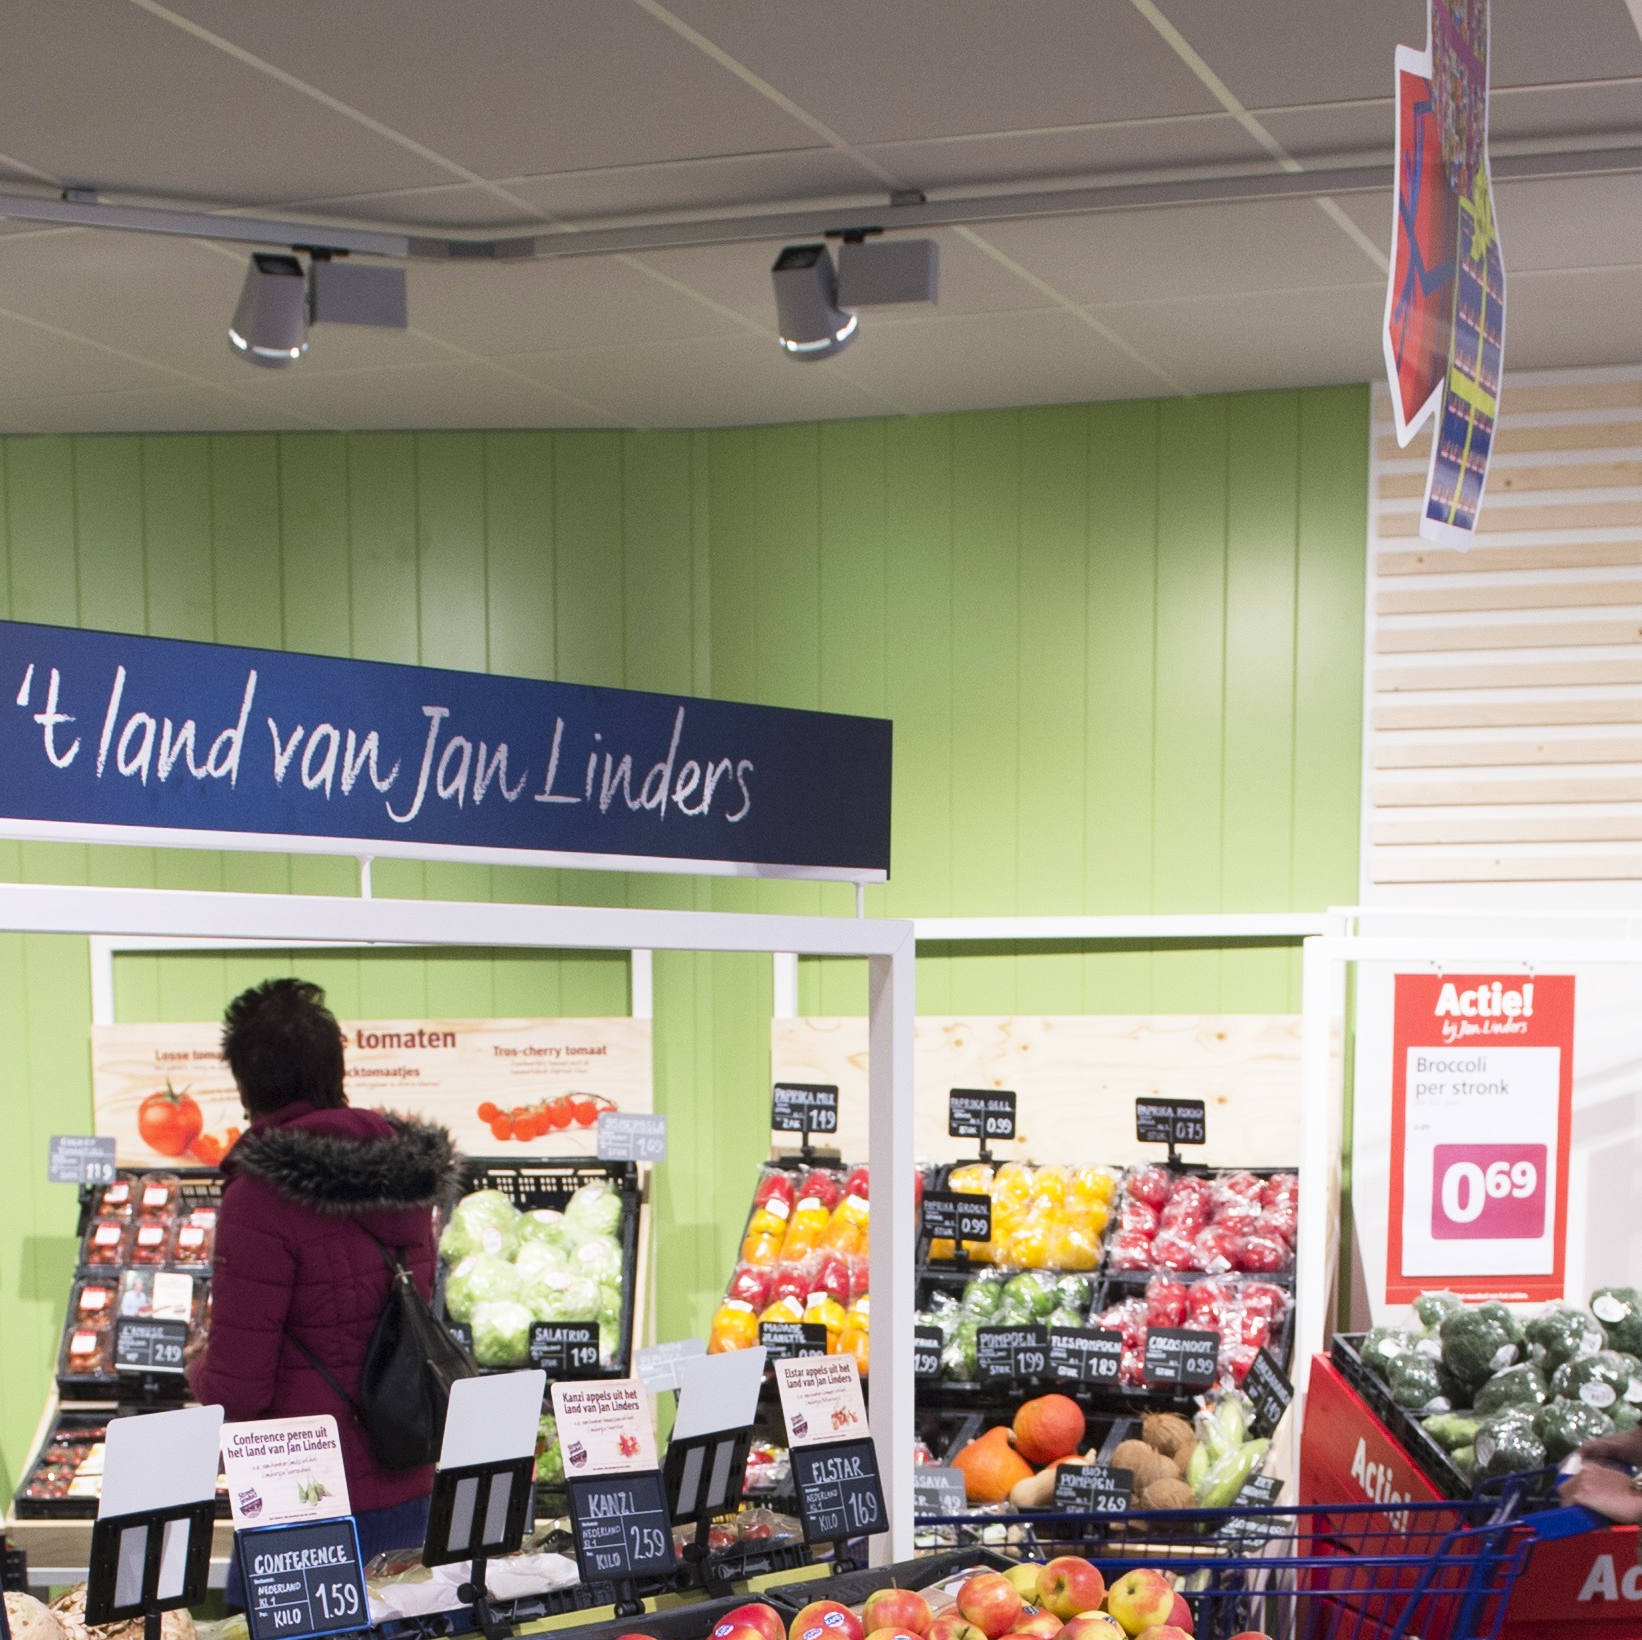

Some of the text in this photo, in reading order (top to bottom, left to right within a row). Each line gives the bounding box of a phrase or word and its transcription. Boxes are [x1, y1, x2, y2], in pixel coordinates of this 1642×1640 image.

[17, 663, 81, 768] 't
[95, 669, 240, 790] land
[268, 715, 404, 798] van
[386, 705, 529, 823] Jan
[534, 707, 755, 823] Linders
[1434, 981, 1534, 1017] Actie!
[357, 1029, 456, 1049] tomaten
[155, 1050, 189, 1061] Losse
[493, 1045, 607, 1058] Tros-cherry tomaat
[1416, 1057, 1487, 1073] Broccoli
[1416, 1079, 1509, 1098] per stronk
[535, 1328, 590, 1341] SALATRIO
[979, 1332, 1037, 1347] POMPOEN
[784, 1363, 851, 1378] Elstar appels uit het
[787, 1375, 852, 1388] land van Jan Linders
[562, 1389, 637, 1404] Kanzi appels uit het
[564, 1401, 640, 1414] land van Jan Linders
[233, 1426, 328, 1446] Conference peren uit
[227, 1439, 337, 1459] het land van Jan Linders
[811, 1456, 864, 1484] ELSTAR
[1060, 1474, 1115, 1489] POMPOEN
[588, 1491, 636, 1518] KANZI
[806, 1489, 837, 1503] NEDERLAND
[819, 1513, 838, 1532] KILO
[582, 1525, 621, 1539] NEDERLAND
[254, 1544, 348, 1575] CONFERENCE
[596, 1552, 621, 1570] KILO
[258, 1582, 301, 1595] NEDERLAND
[315, 1583, 359, 1618] 1.59
[274, 1608, 302, 1628] KILO
